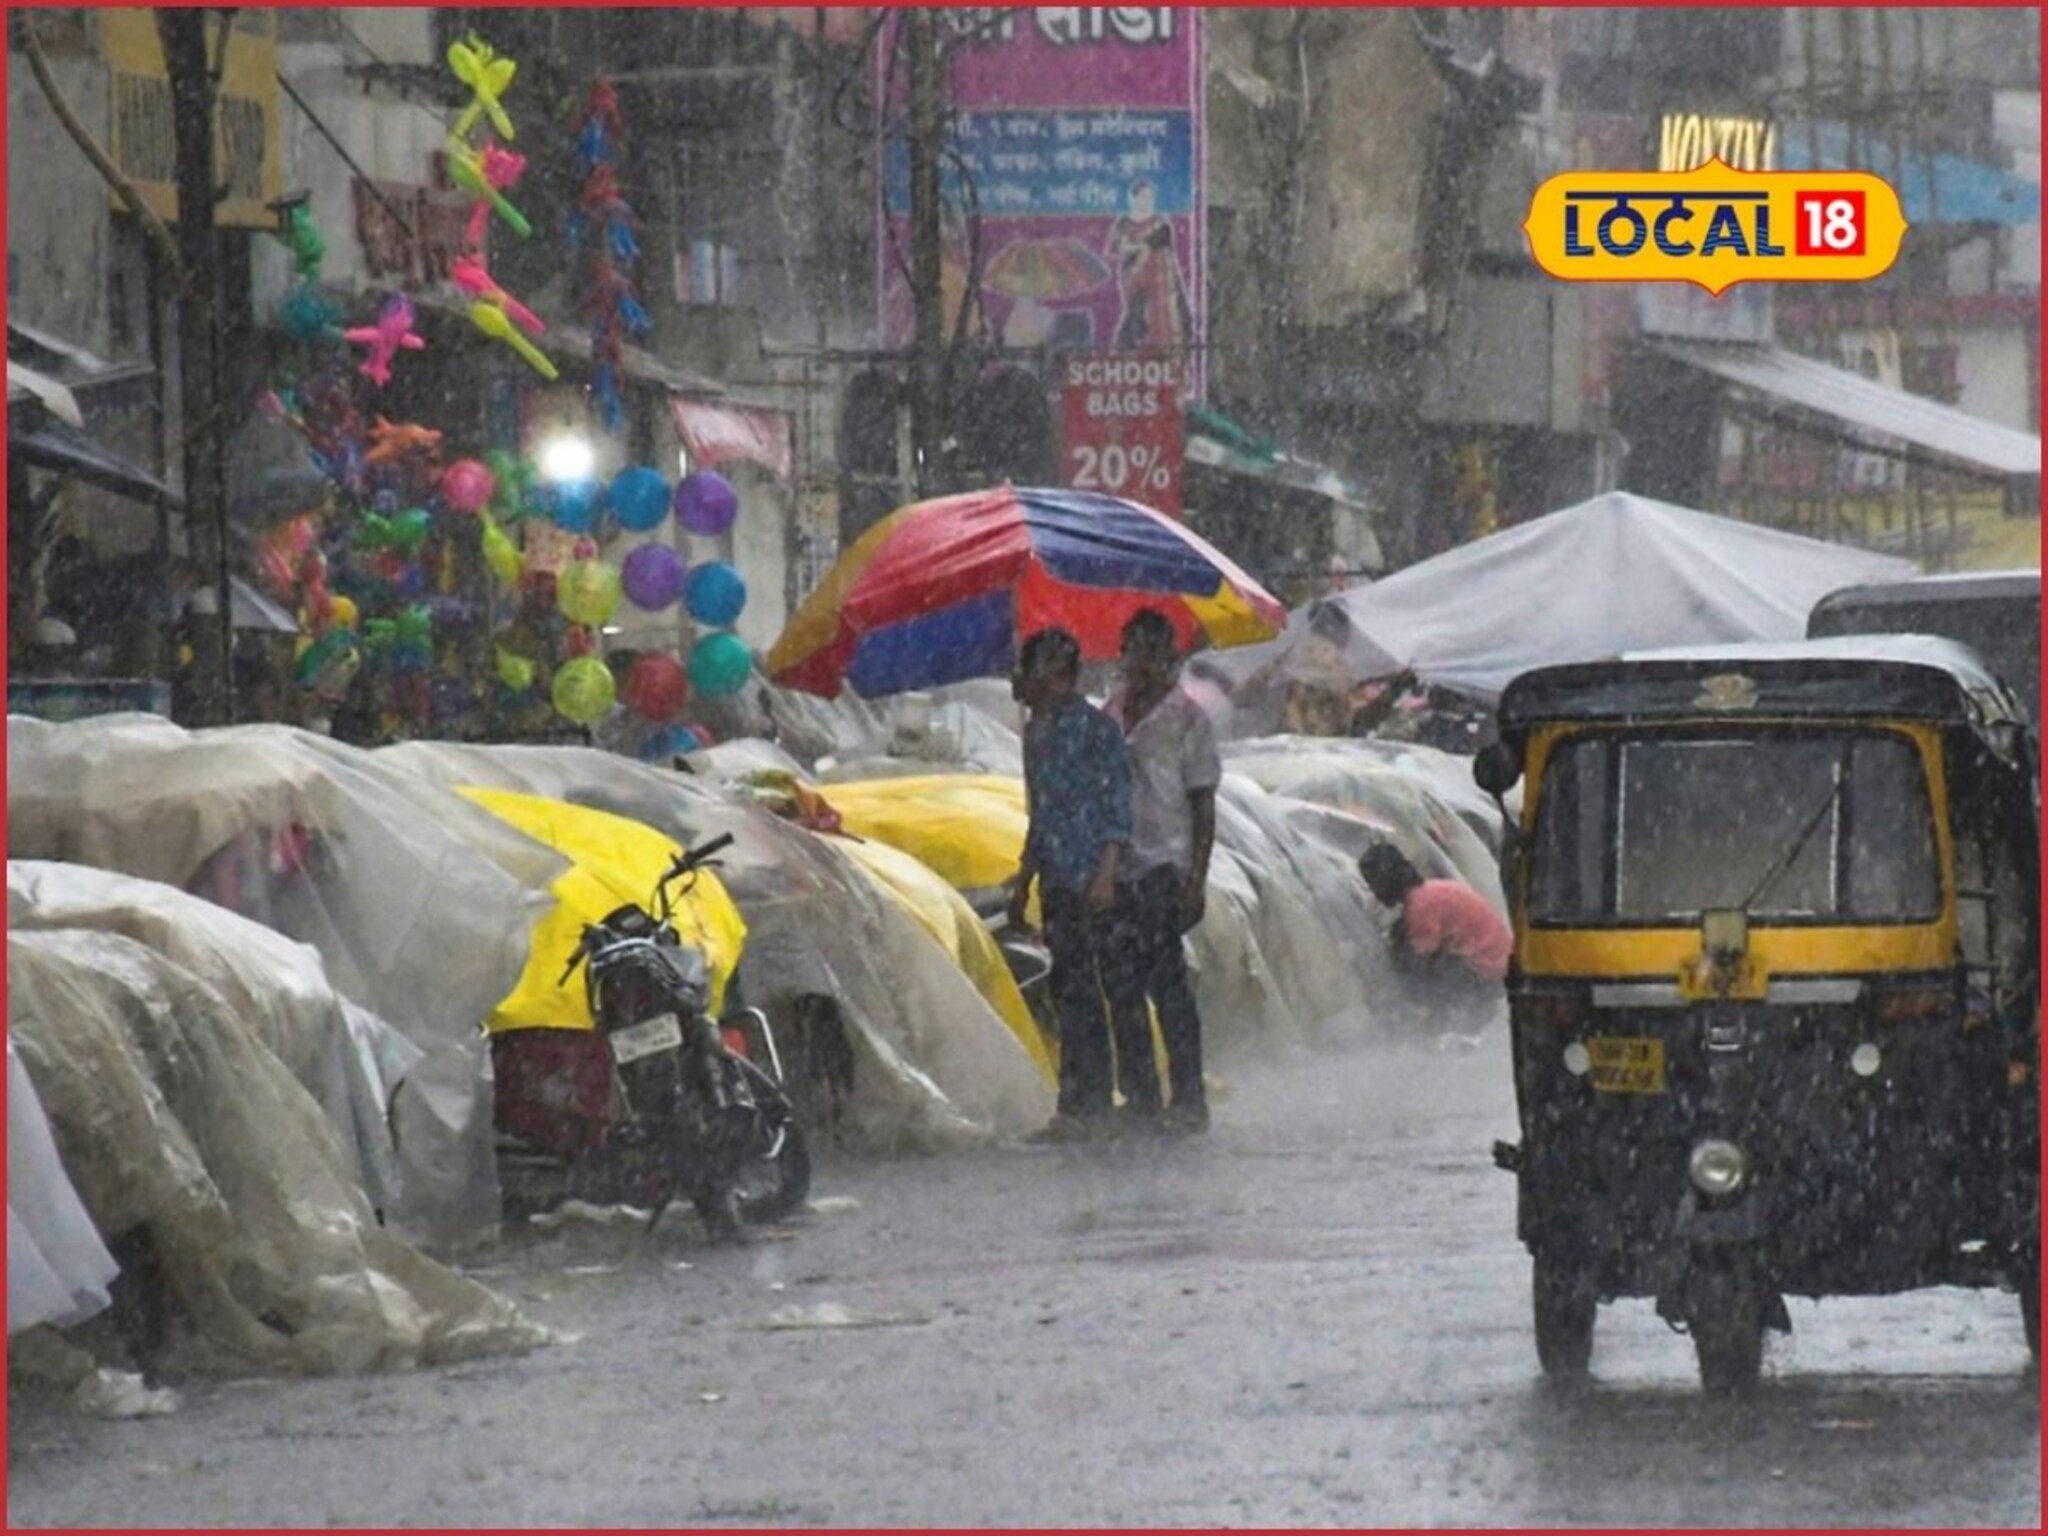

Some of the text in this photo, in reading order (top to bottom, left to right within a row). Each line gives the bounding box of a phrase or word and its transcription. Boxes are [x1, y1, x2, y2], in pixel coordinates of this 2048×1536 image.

[1068, 360, 1176, 386] SCHOOL
[1088, 391, 1158, 417] BAGS
[1071, 444, 1171, 490] 20%
